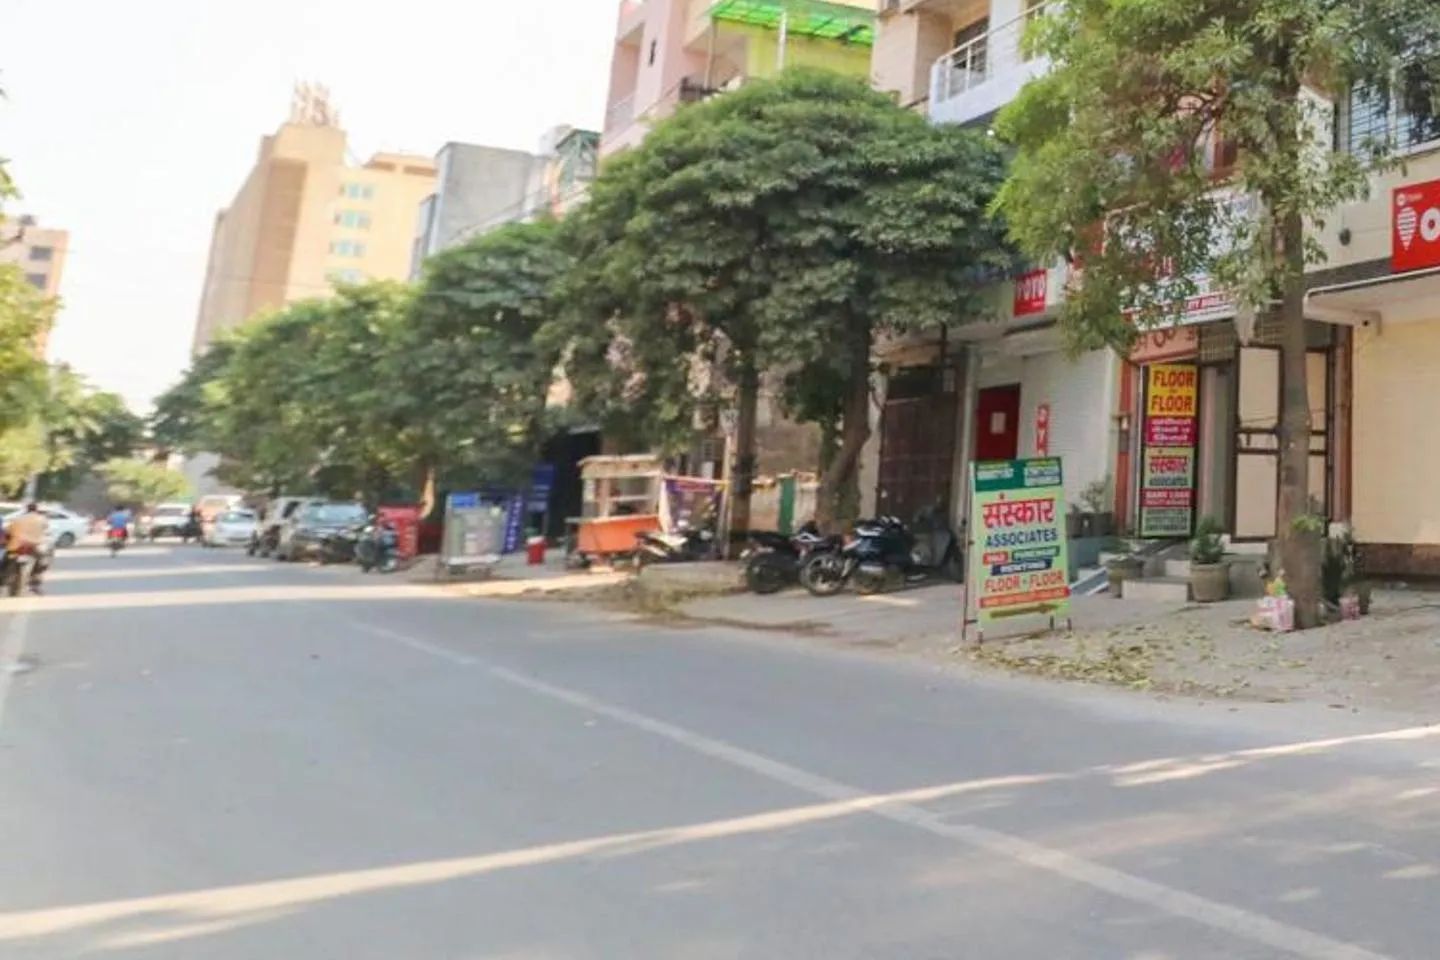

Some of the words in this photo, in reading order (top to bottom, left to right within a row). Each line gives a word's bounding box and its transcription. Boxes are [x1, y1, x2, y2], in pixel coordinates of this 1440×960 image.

[1153, 370, 1194, 388] FLOOR
[1151, 394, 1193, 411] FLOOR
[982, 493, 1055, 528] संस्कार
[985, 528, 1057, 547] ASSOCIATES
[984, 576, 1019, 593] FLOOR
[1030, 571, 1064, 589] FLOOR
